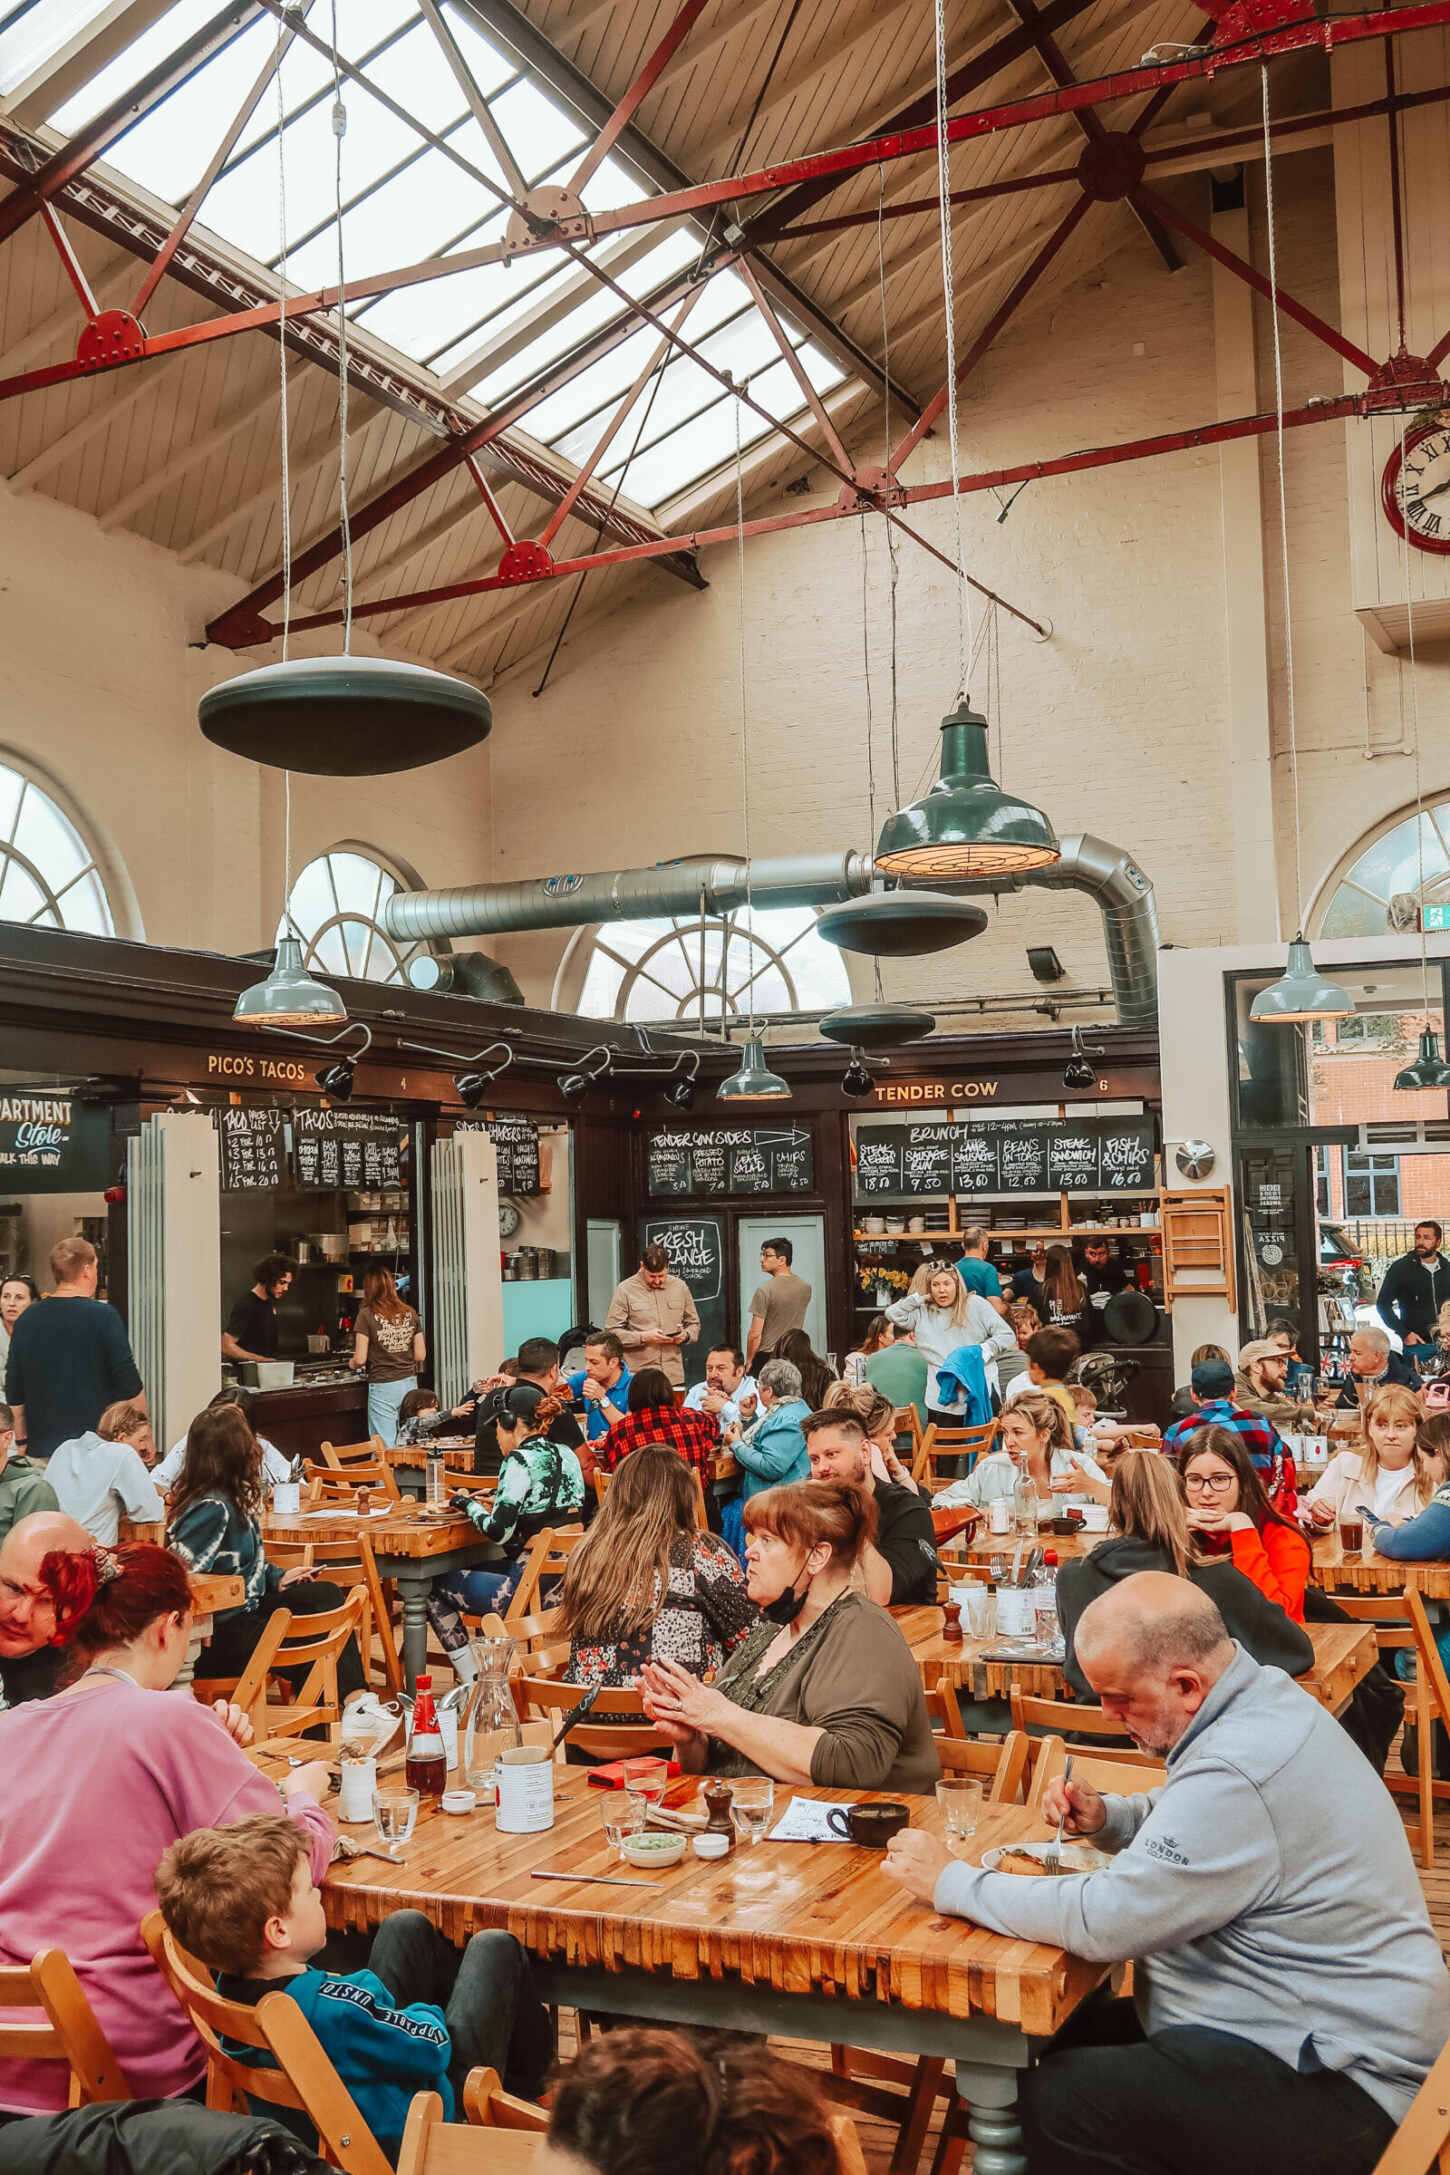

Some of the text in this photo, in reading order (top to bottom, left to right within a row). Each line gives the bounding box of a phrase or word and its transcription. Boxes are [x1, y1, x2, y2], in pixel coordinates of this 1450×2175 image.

[208, 1055, 305, 1080] PICO'S TACOS
[875, 1082, 998, 1101] TENDER COW
[1100, 1079, 1109, 1091] 6
[0, 1098, 72, 1125] ARTMENT
[296, 1108, 334, 1131] TACOS
[651, 1130, 752, 1147] TENDER COW SIDES
[910, 1124, 968, 1143] BRUNCH
[860, 1144, 893, 1155] STEAK
[960, 1139, 988, 1152] LAMB
[1003, 1139, 1040, 1153] BEANS
[1054, 1138, 1091, 1150] STEAK
[1106, 1136, 1140, 1152] FISH
[776, 1151, 805, 1163] CHIPS
[905, 1149, 950, 1162] SAUSAGE
[953, 1151, 997, 1162] SAUSAGE
[1014, 1150, 1045, 1161] TOAST
[1050, 1148, 1097, 1162] SANDWICH
[911, 1160, 934, 1170] BUN
[653, 1229, 705, 1250] FRESH
[1145, 1838, 1190, 1866] LONDON
[320, 1982, 372, 2007] UNSTO
